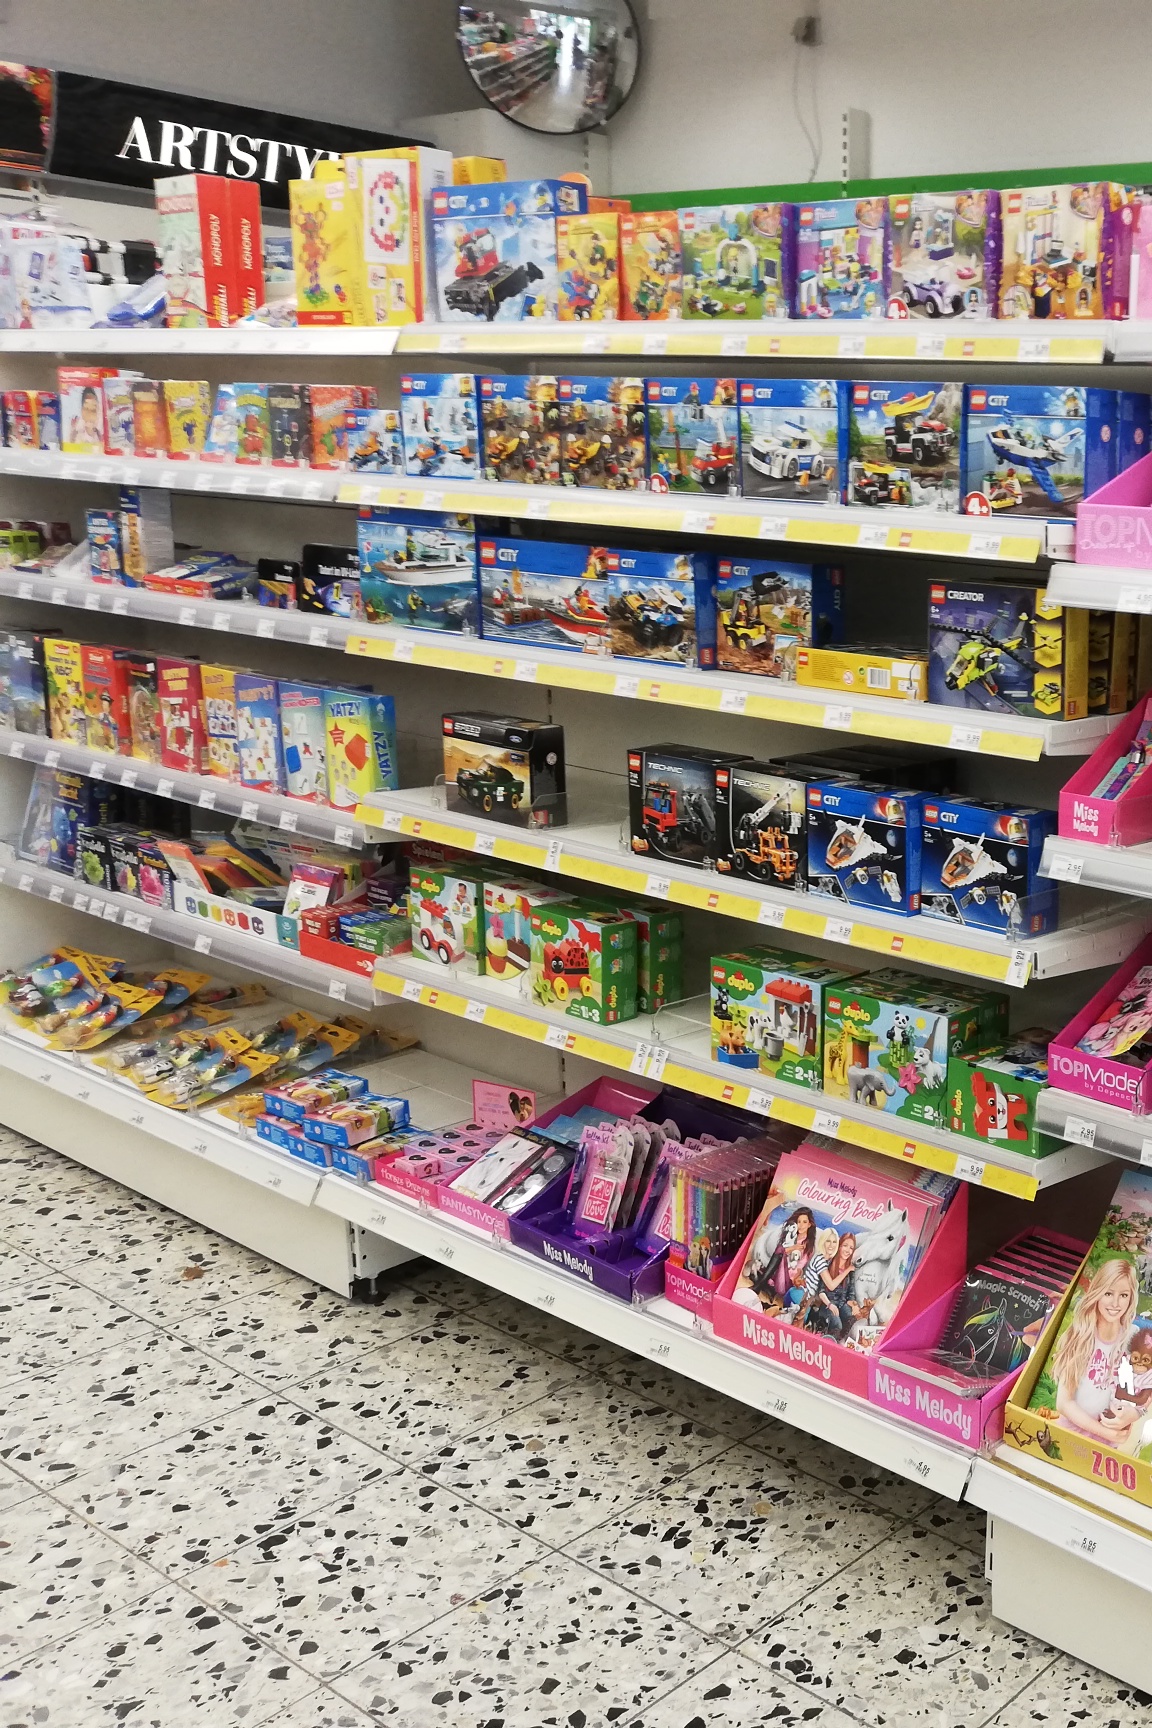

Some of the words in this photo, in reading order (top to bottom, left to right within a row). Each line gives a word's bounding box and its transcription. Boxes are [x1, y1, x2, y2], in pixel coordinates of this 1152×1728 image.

[116, 117, 345, 183] ARTSTY
[209, 214, 222, 266] MONOPOLY
[240, 218, 253, 269] MONOPOLY
[947, 591, 985, 603] CREATOR
[329, 701, 362, 718] YATZY
[374, 730, 392, 780] YATZY
[648, 762, 683, 774] TECHNIC
[733, 778, 771, 792] TECHNIC
[823, 795, 842, 807] CITY
[1073, 801, 1099, 819] Miss
[940, 811, 960, 824] CITY
[1073, 818, 1099, 837] Melody
[1068, 863, 1082, 873] 2.95
[727, 974, 755, 992] duplo
[843, 1004, 870, 1022] duplo
[1051, 1054, 1143, 1096] TOPModel
[1084, 1082, 1095, 1092] by
[1080, 1127, 1095, 1137] 2.95
[970, 1165, 983, 1176] 9.99
[828, 1177, 840, 1190] Miss
[839, 1181, 858, 1197] Melody
[797, 1178, 850, 1217] Colouring
[850, 1200, 884, 1223] Book
[543, 1241, 563, 1261] Miss
[564, 1249, 594, 1282] Melody
[975, 1279, 1006, 1296] Magic
[1007, 1286, 1041, 1311] Scratch
[743, 1314, 775, 1350] Miss
[778, 1325, 832, 1379] Melody
[874, 1369, 912, 1406] Miss
[914, 1385, 972, 1440] Melody
[918, 1461, 930, 1474] 4.95
[1091, 1451, 1137, 1492] ZOO
[1083, 1537, 1097, 1549] 5.95
